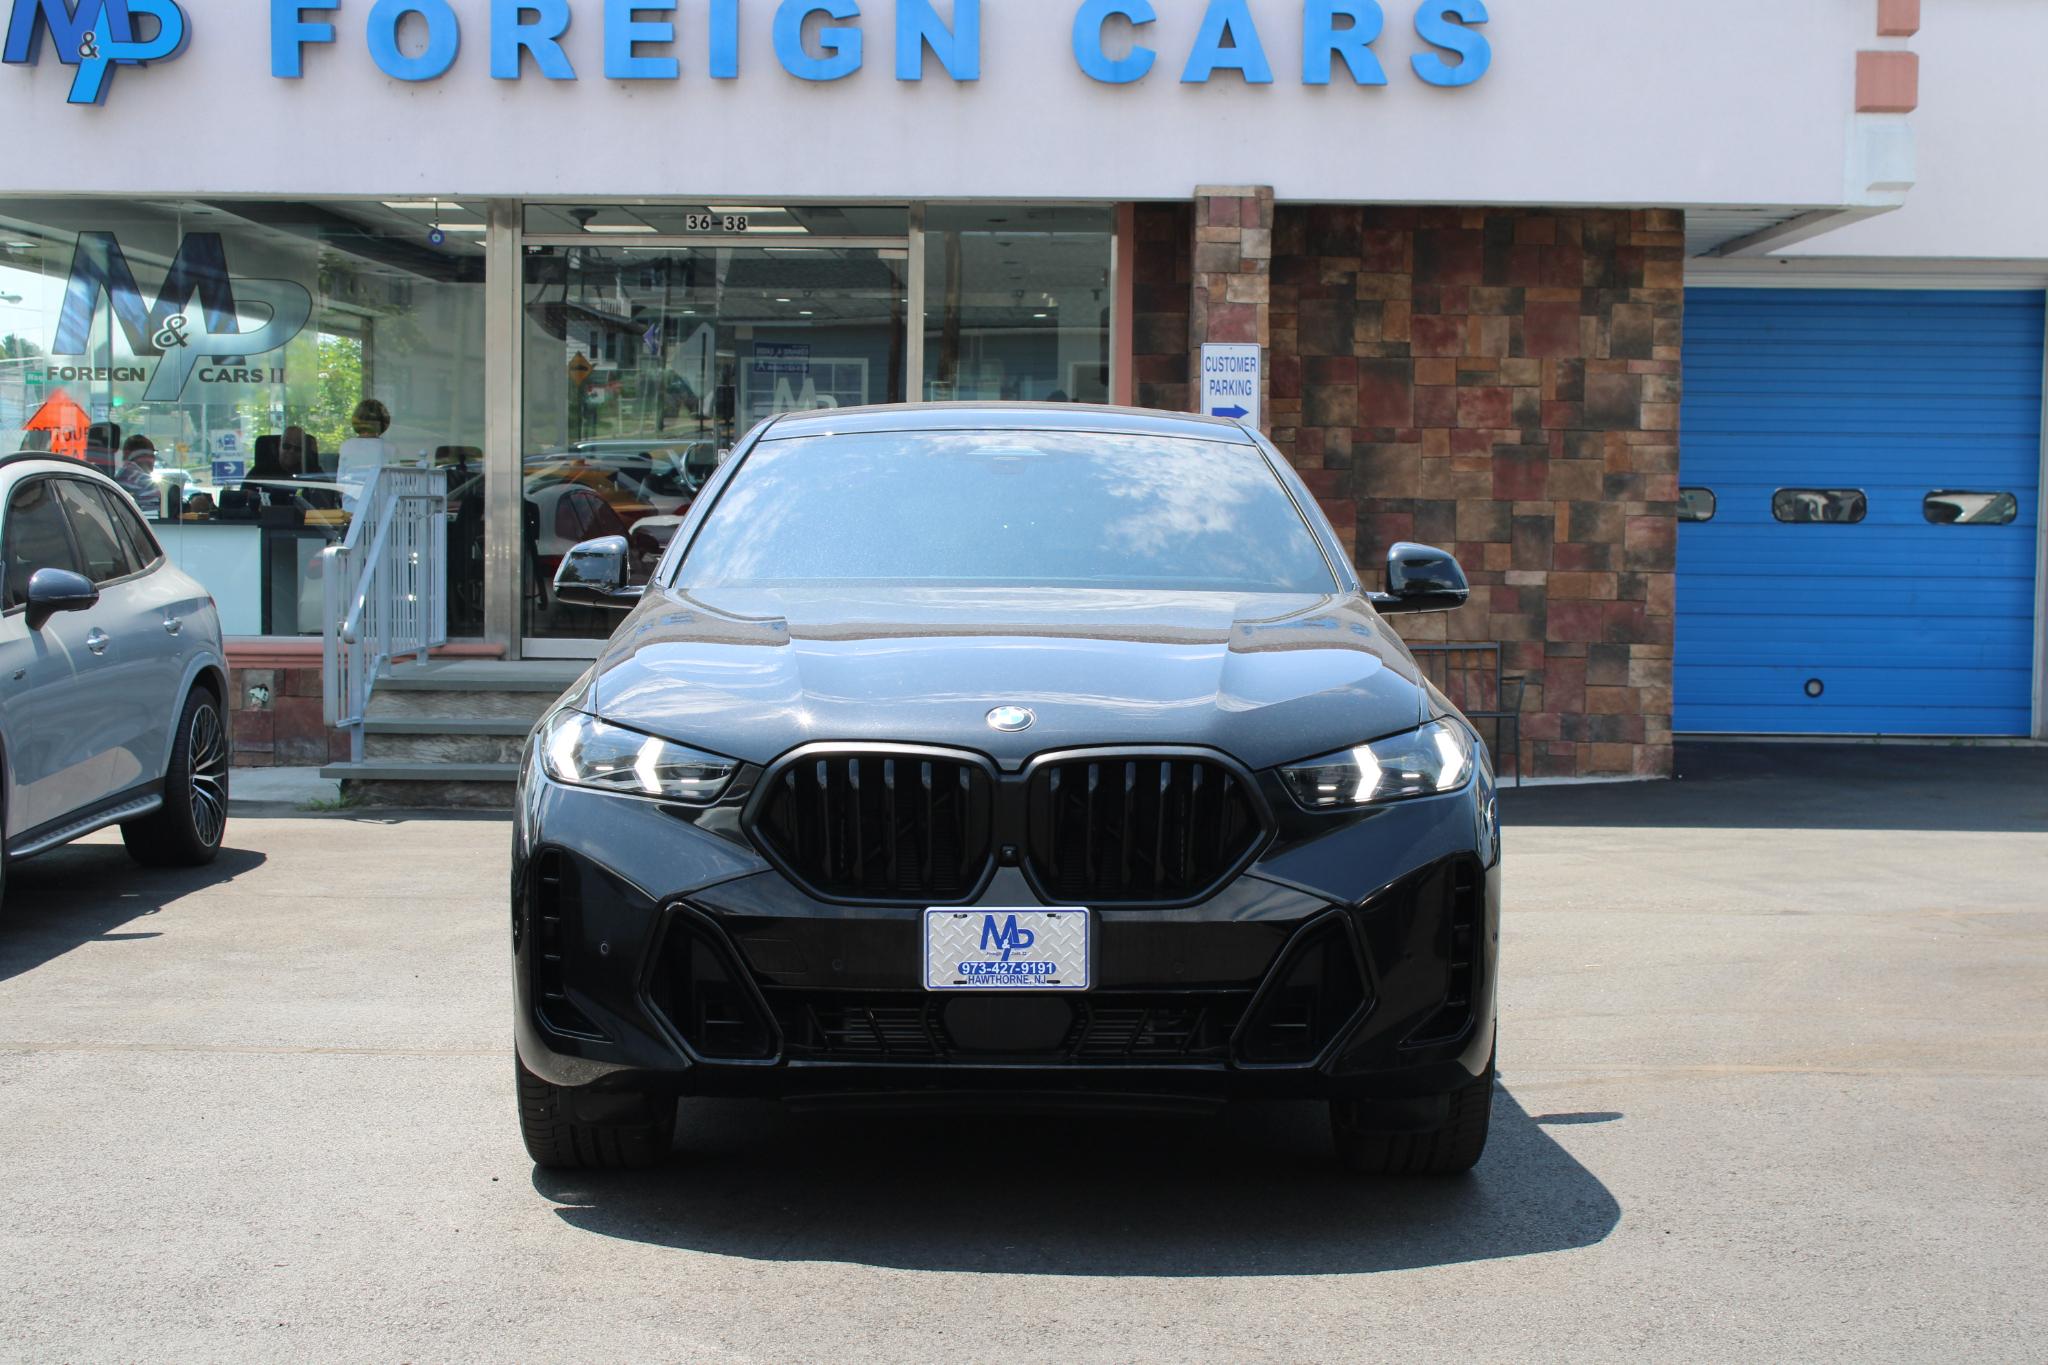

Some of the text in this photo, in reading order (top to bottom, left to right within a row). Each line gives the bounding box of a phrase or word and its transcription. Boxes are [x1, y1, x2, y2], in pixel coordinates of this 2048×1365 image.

[271, 0, 981, 82] FOREIGN
[1072, 0, 1492, 87] CARS
[688, 215, 747, 231] 36-38
[1205, 356, 1257, 373] CUSTOMER
[47, 366, 146, 382] FOREIGN
[199, 367, 264, 384] CARS
[270, 367, 285, 384] II
[1209, 379, 1253, 396] PARKING
[962, 962, 1053, 975] 973-427-9191
[968, 975, 1046, 985] HAWTHORNE, NJ
